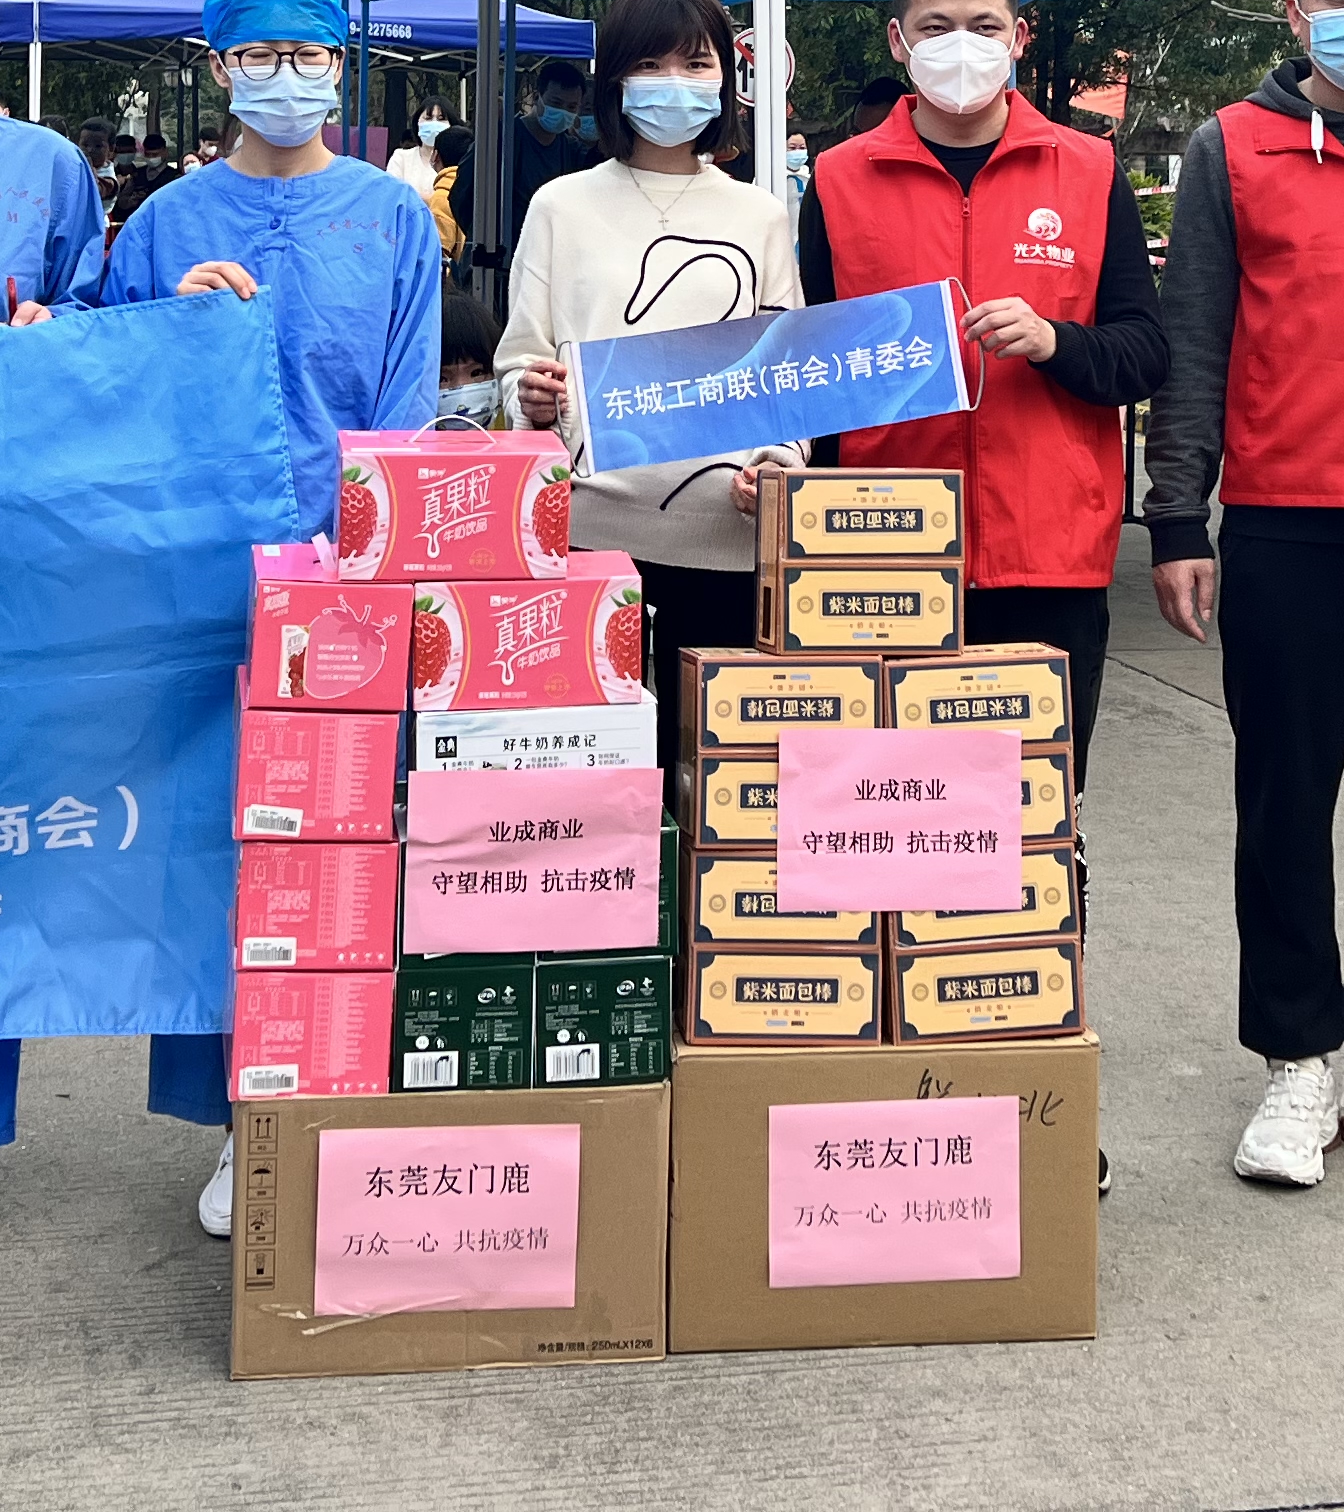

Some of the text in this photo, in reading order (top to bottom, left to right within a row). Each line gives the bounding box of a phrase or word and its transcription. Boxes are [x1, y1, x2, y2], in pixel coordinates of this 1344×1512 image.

[1013, 243, 1075, 264] 光大物业
[602, 335, 933, 420] 东城工商联(商会)青委会
[420, 469, 492, 533] 真果粒
[442, 517, 488, 543] 牛奶饮品
[828, 595, 915, 615] 紫米面包棒
[493, 594, 564, 660] 真果粒
[517, 642, 561, 670] 牛奶饮品
[502, 734, 597, 752] 好牛奶养成记
[514, 757, 523, 771] 2
[586, 753, 596, 767] 3
[854, 778, 948, 803] 业成商业
[487, 818, 584, 844] 业成商业
[802, 829, 1000, 856] 守望相助 抗击疫情
[431, 866, 636, 895] 守望相助 抗击疫情
[742, 981, 832, 1002] 紫米面包棒
[944, 975, 1033, 1000] 紫米面包棒
[813, 1134, 974, 1172] 东莞友门鹿
[364, 1162, 532, 1199] 东莞友门鹿
[794, 1195, 994, 1228] 万众一心 共抗疫情
[341, 1226, 550, 1257] 万众一心 共抗疫情
